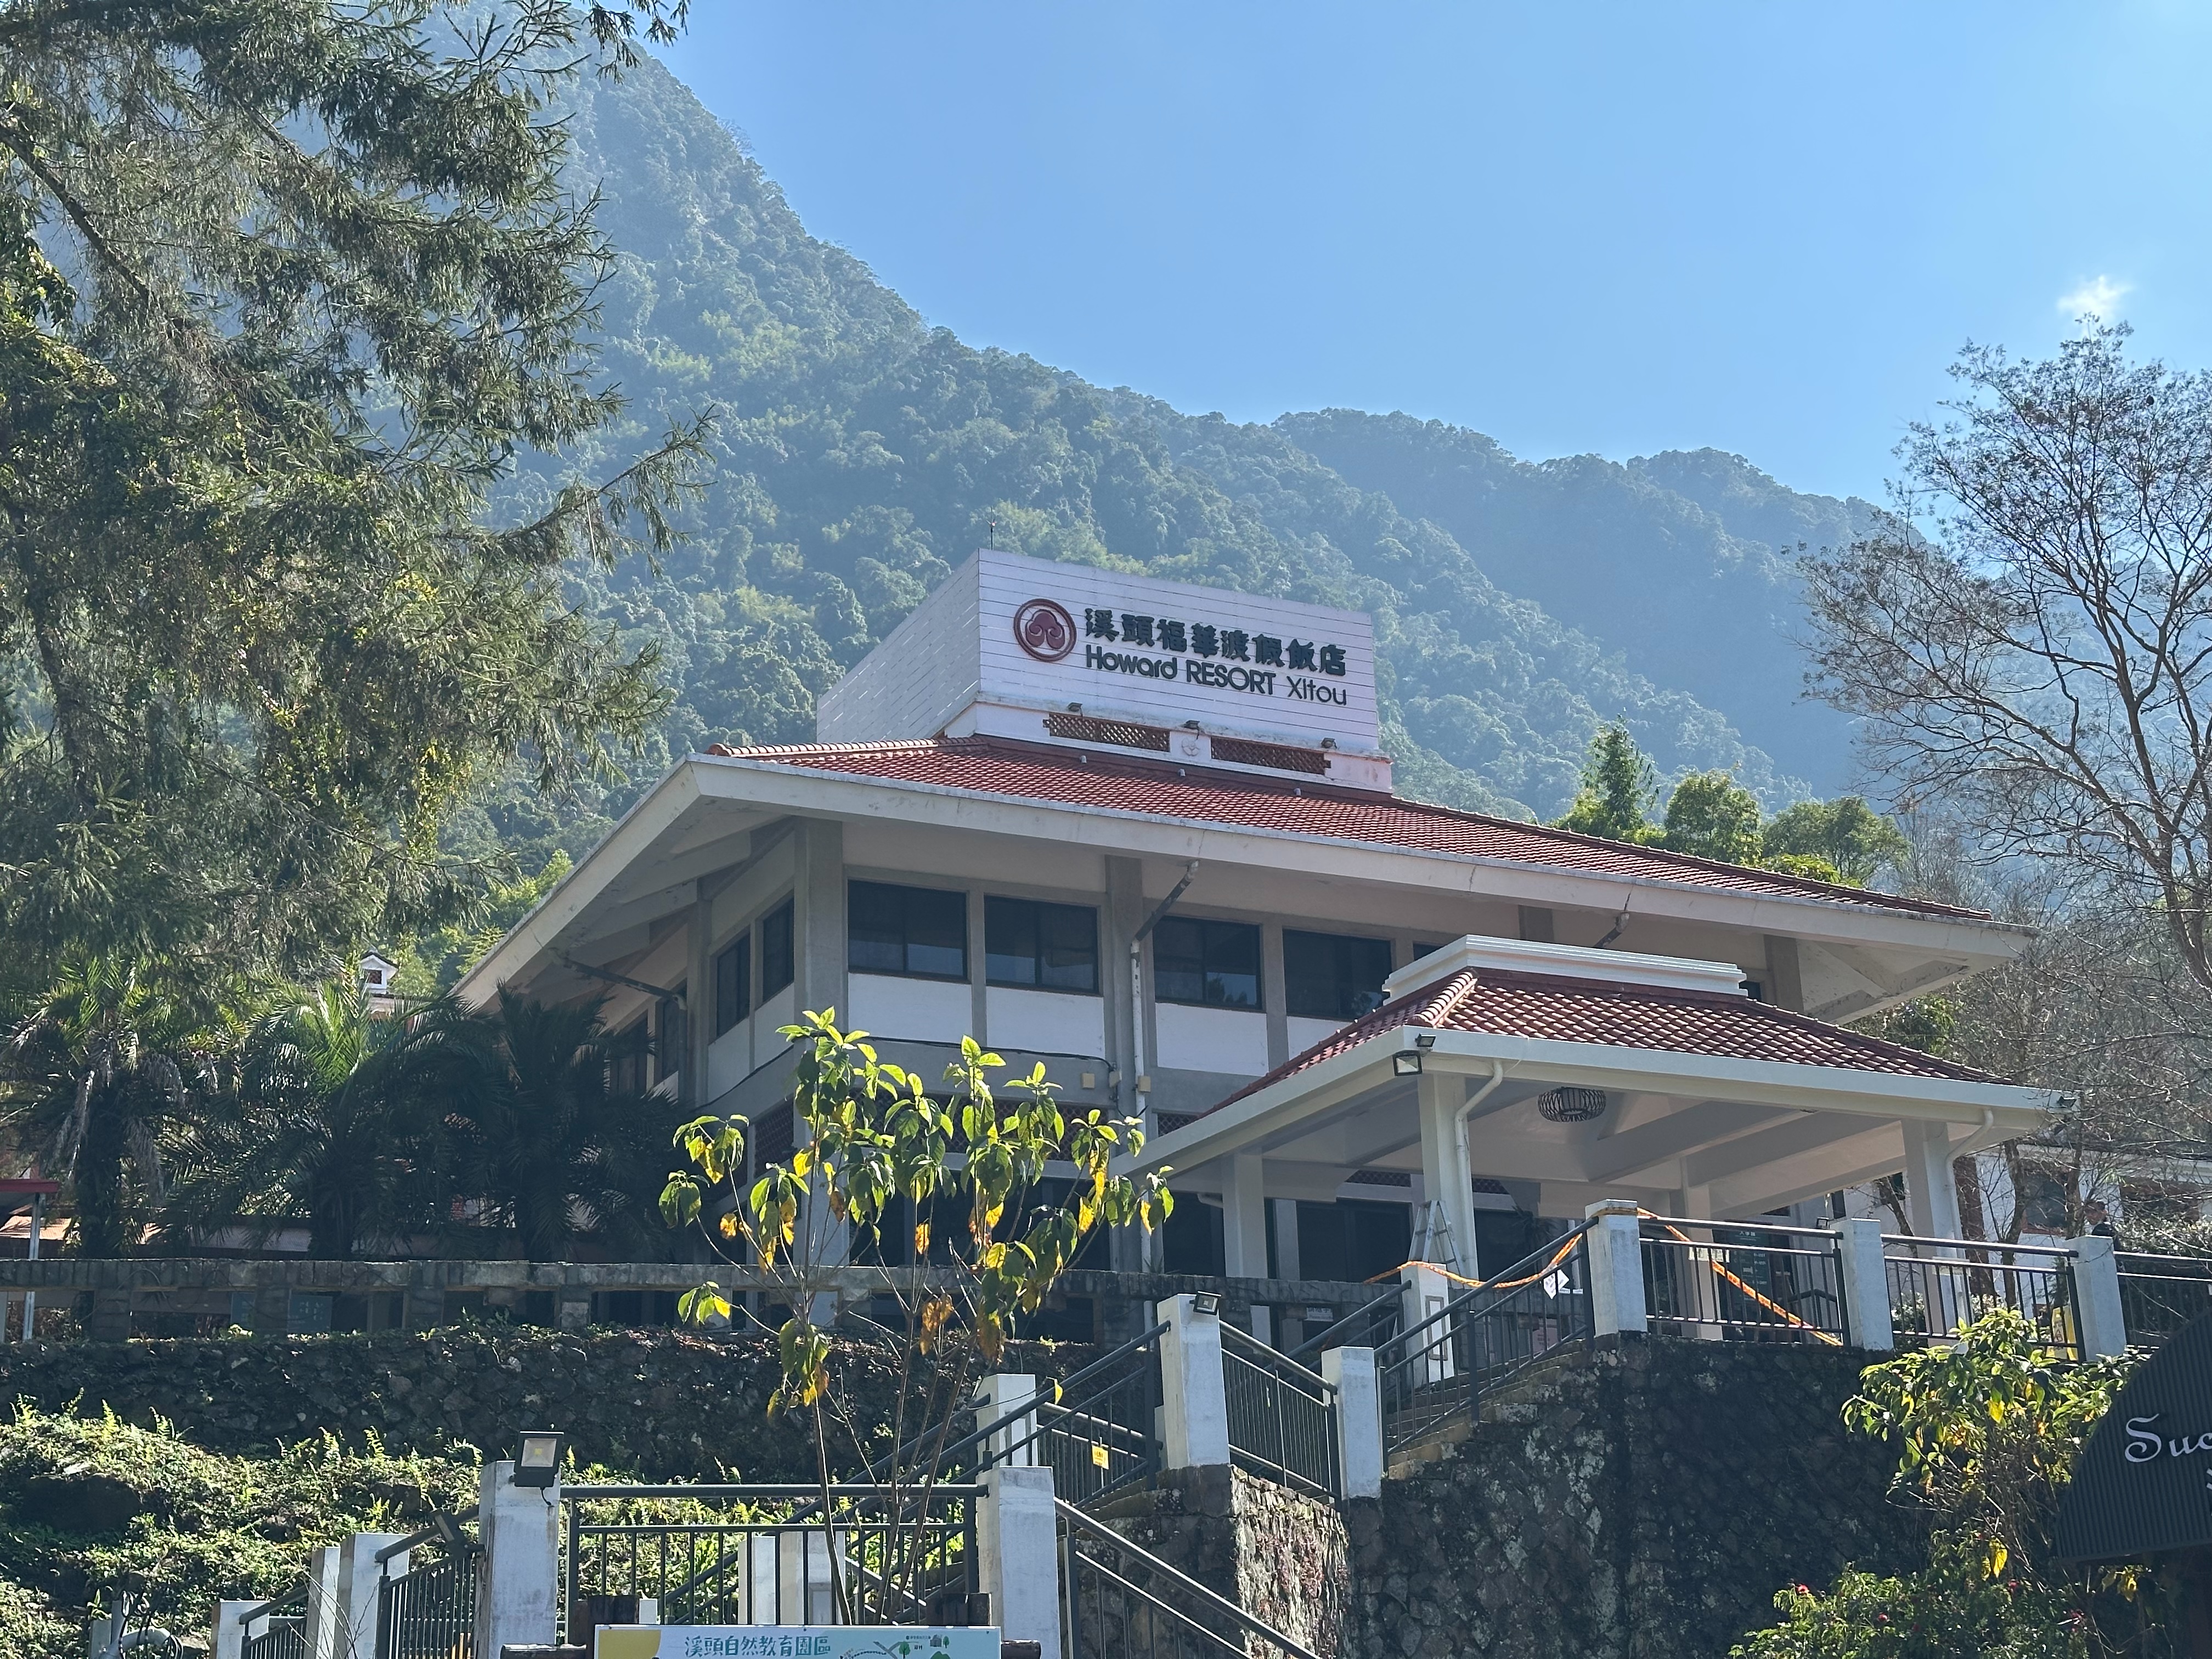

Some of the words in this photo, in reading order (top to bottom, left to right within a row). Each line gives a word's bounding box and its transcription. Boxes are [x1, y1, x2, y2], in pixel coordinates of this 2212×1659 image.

[1085, 608, 1346, 676] 溪頭福華渡假飯店
[1086, 644, 1177, 679] Howard
[1186, 659, 1277, 695] RESORT
[685, 1635, 831, 1657] 溪頭自然教育園區
